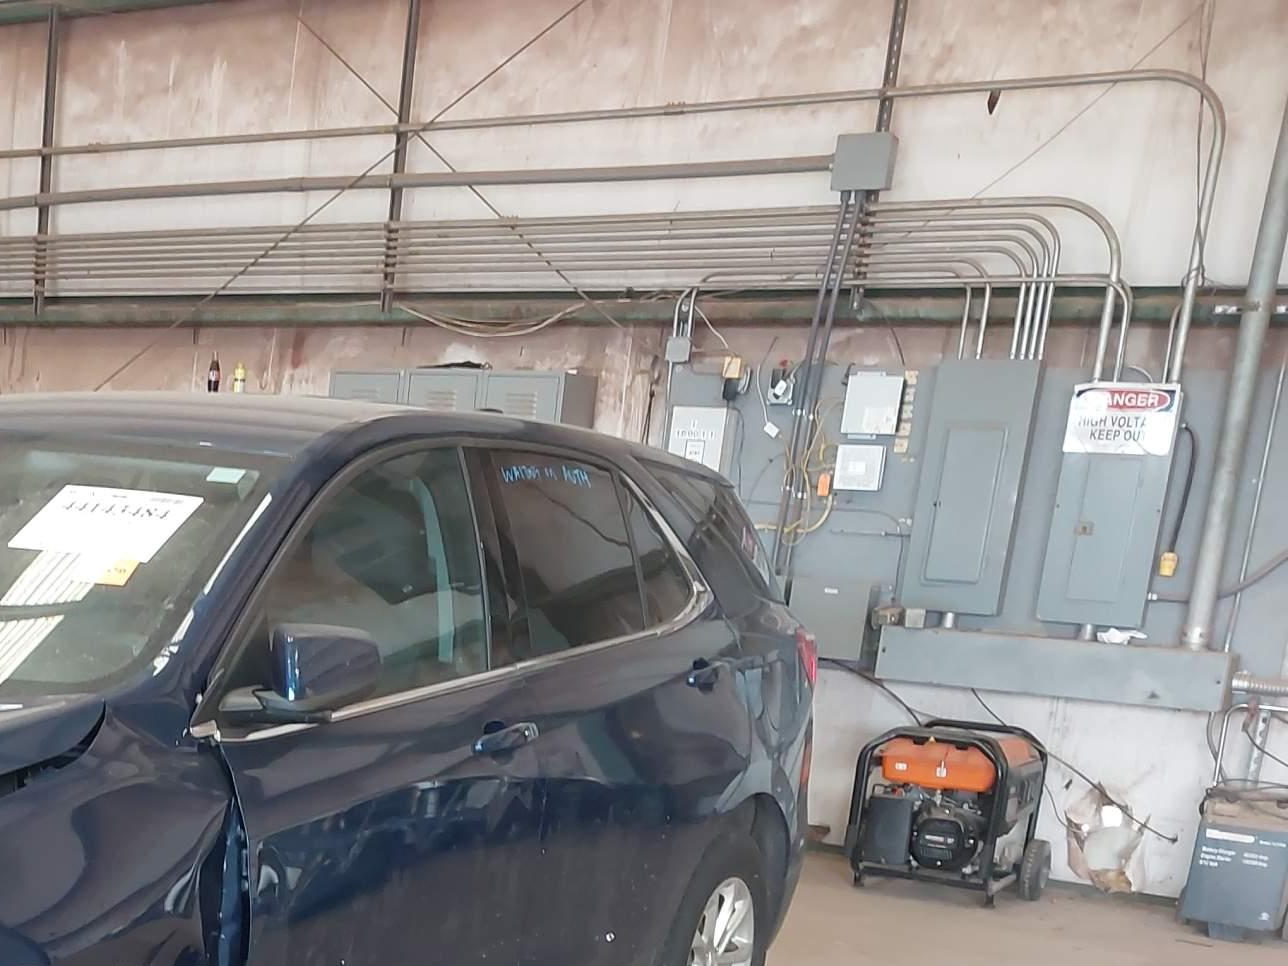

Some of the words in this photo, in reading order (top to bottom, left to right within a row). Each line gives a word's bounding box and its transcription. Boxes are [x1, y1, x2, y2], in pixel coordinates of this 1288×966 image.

[1098, 393, 1159, 407] ANGER
[1111, 416, 1147, 429] VOLTA
[1089, 429, 1121, 441] KEEP
[1123, 431, 1145, 442] OU
